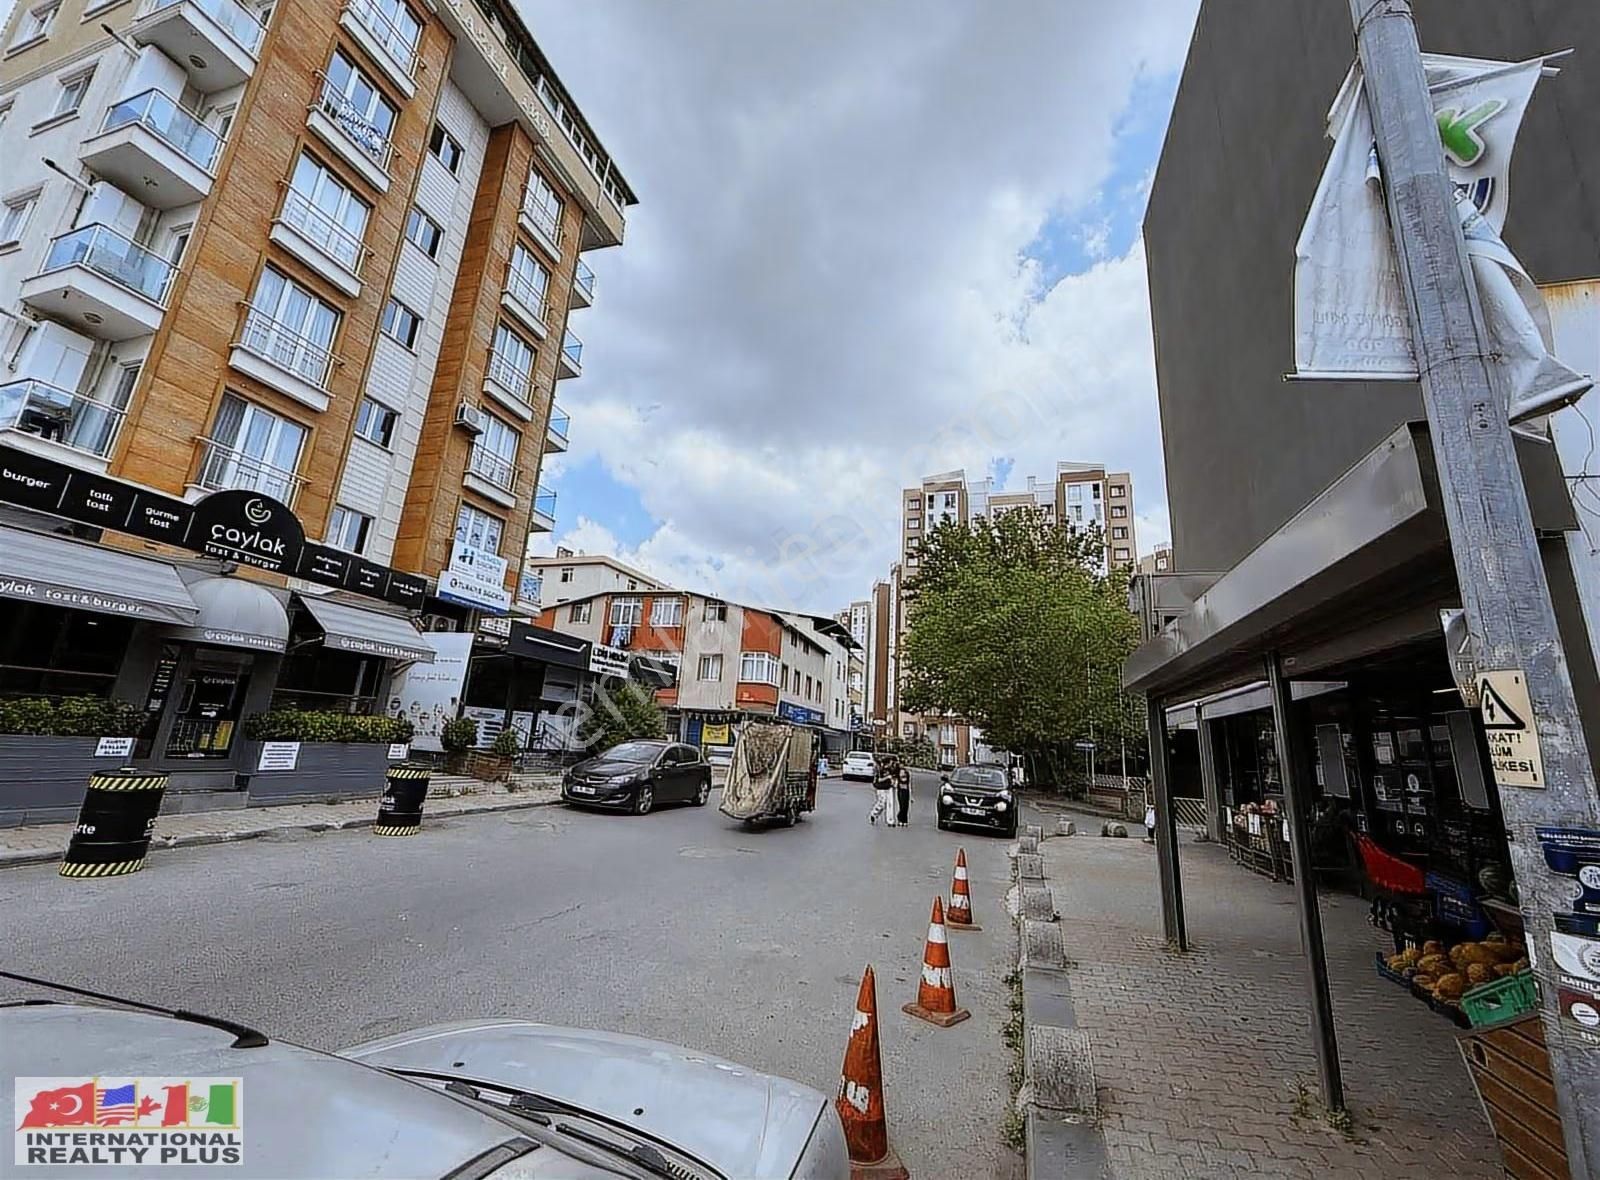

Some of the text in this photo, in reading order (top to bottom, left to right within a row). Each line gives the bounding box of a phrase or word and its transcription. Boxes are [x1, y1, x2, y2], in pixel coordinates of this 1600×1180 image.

[2, 468, 51, 490] burger
[86, 498, 111, 512] tost
[145, 506, 180, 522] gurme
[149, 517, 171, 529] tost
[211, 524, 286, 556] çaylak
[205, 545, 228, 556] tost
[244, 555, 280, 569] burger
